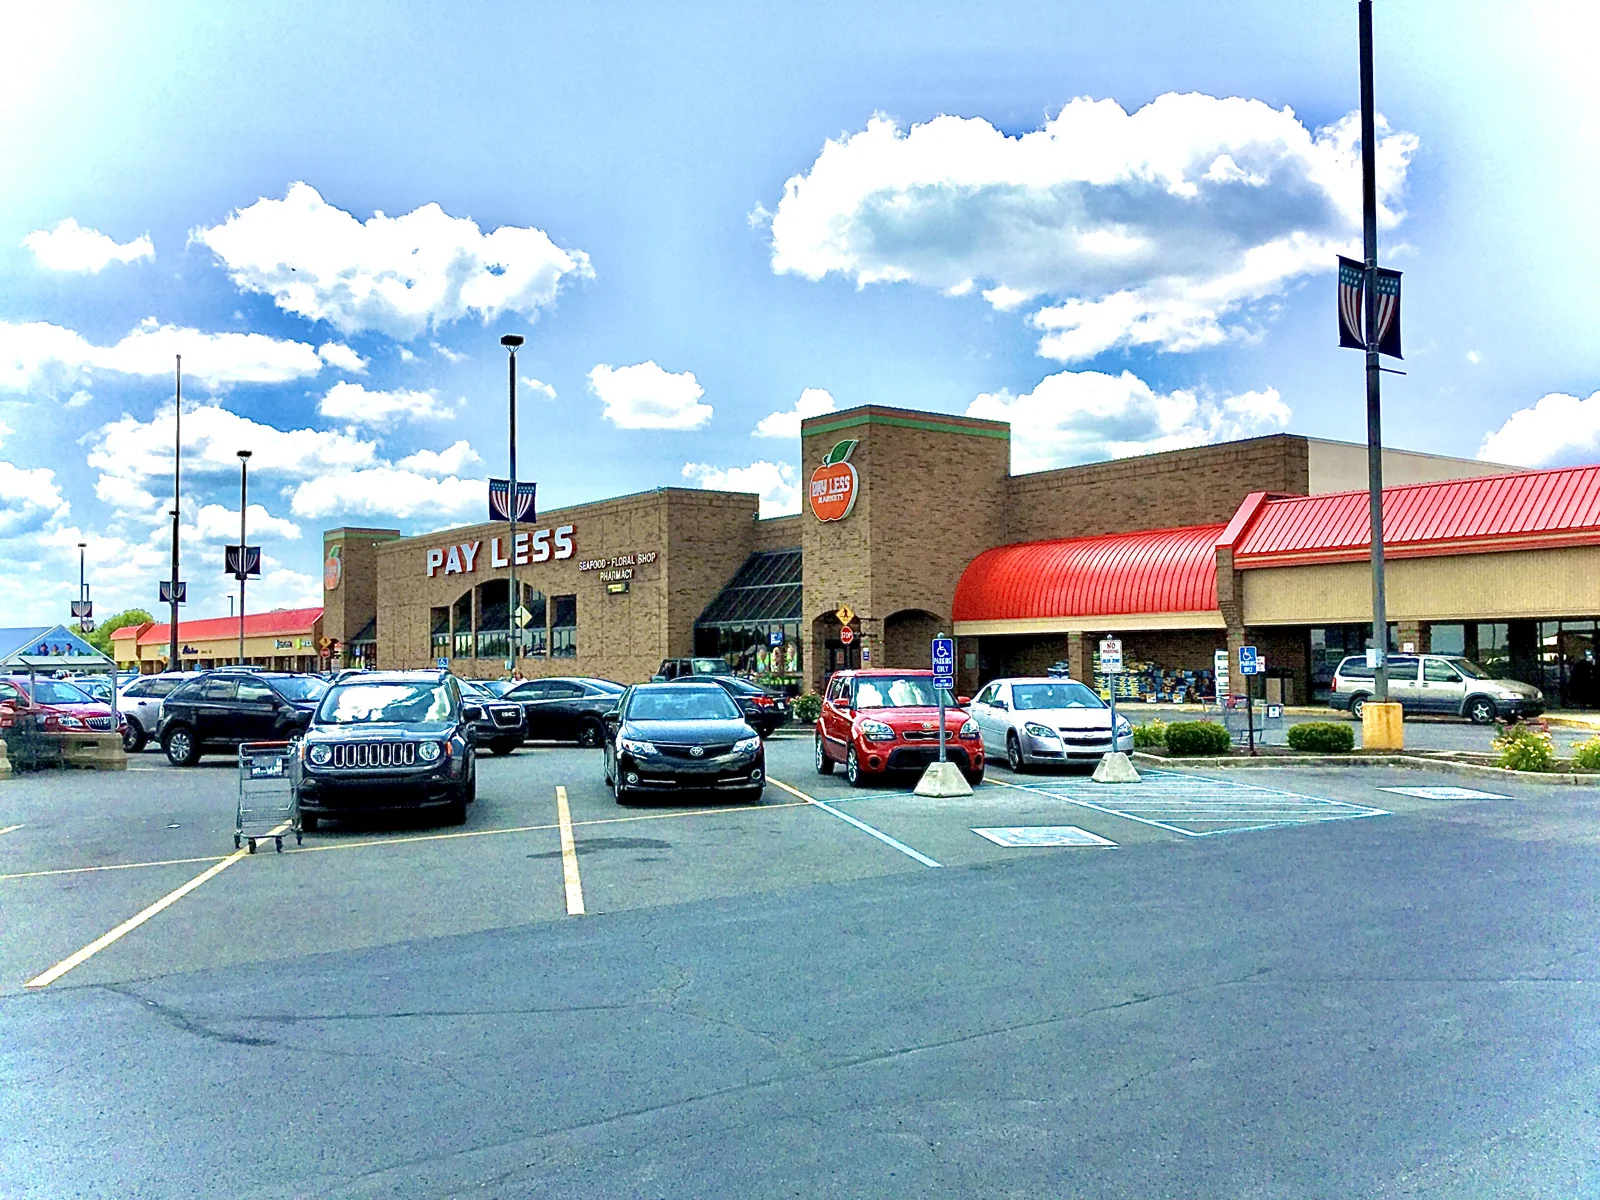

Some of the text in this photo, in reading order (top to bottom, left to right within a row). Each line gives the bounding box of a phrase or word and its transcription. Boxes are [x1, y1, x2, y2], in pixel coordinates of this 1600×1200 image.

[811, 475, 850, 497] PAY LESS
[426, 525, 576, 577] PAY LESS
[578, 559, 607, 572] SEAFOOD
[611, 555, 636, 568] FLORAL
[637, 552, 657, 565] SHOP
[600, 568, 633, 582] PHARMACY
[841, 631, 853, 639] STOP
